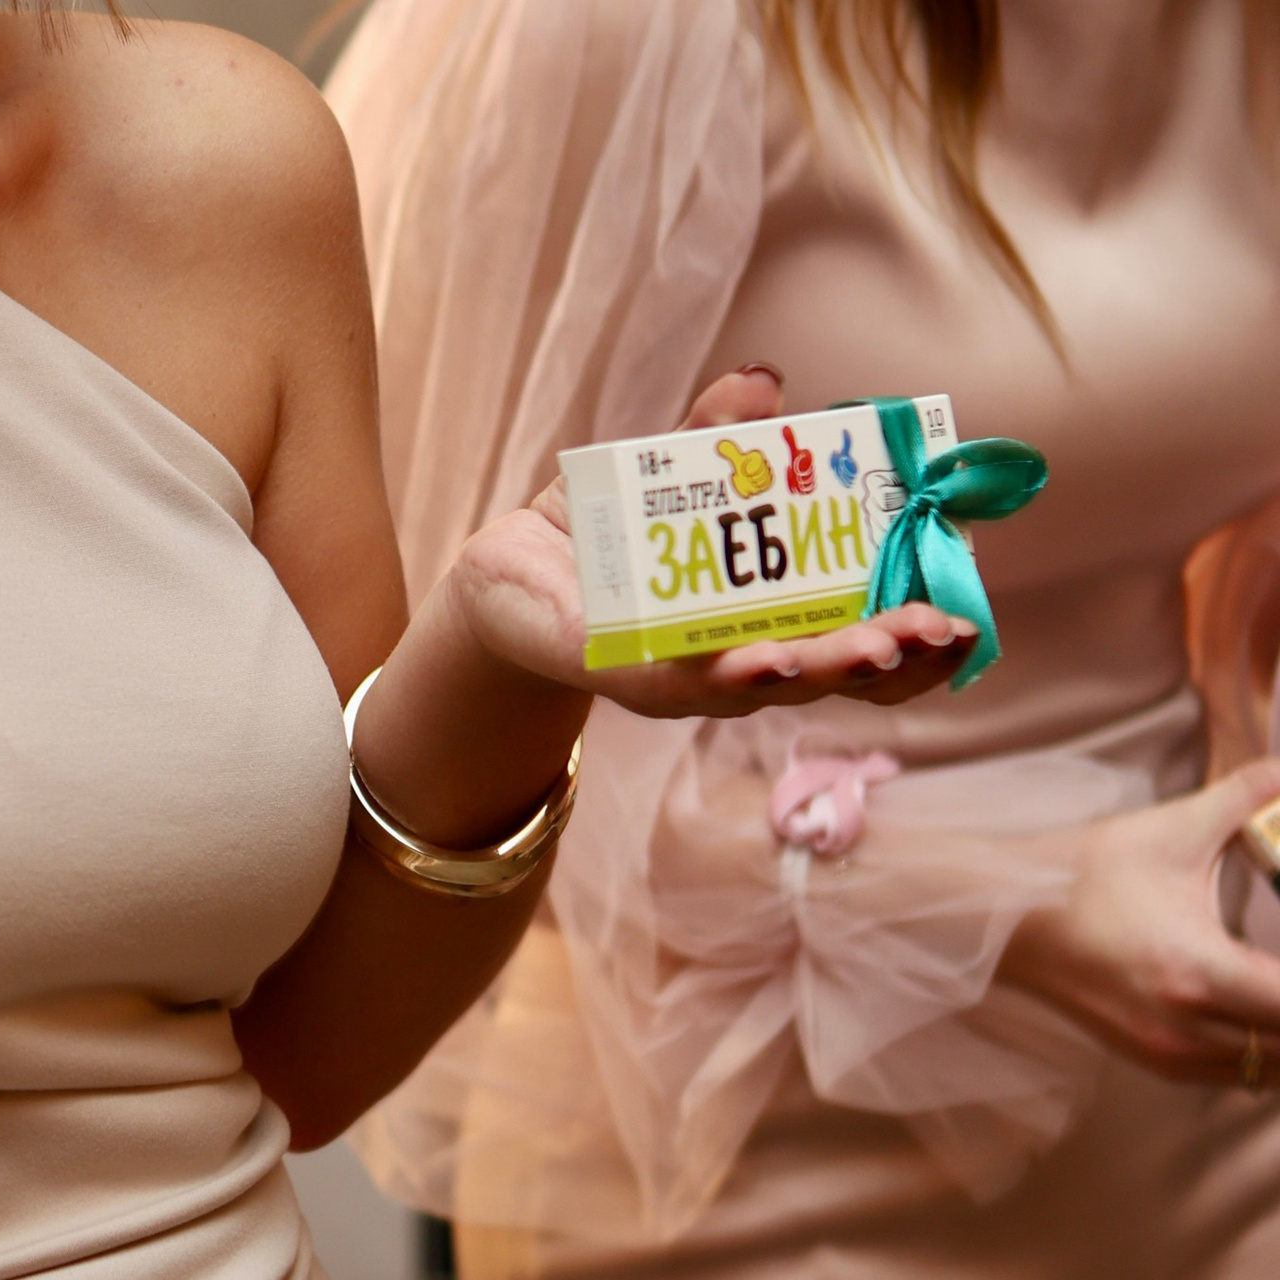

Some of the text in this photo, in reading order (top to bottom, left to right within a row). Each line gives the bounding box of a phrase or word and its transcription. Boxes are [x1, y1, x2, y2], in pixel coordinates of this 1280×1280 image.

[926, 408, 945, 428] 10
[638, 451, 673, 477] 18+
[643, 479, 729, 517] УЛЬТРА
[646, 494, 868, 600] ЗАЕБИН
